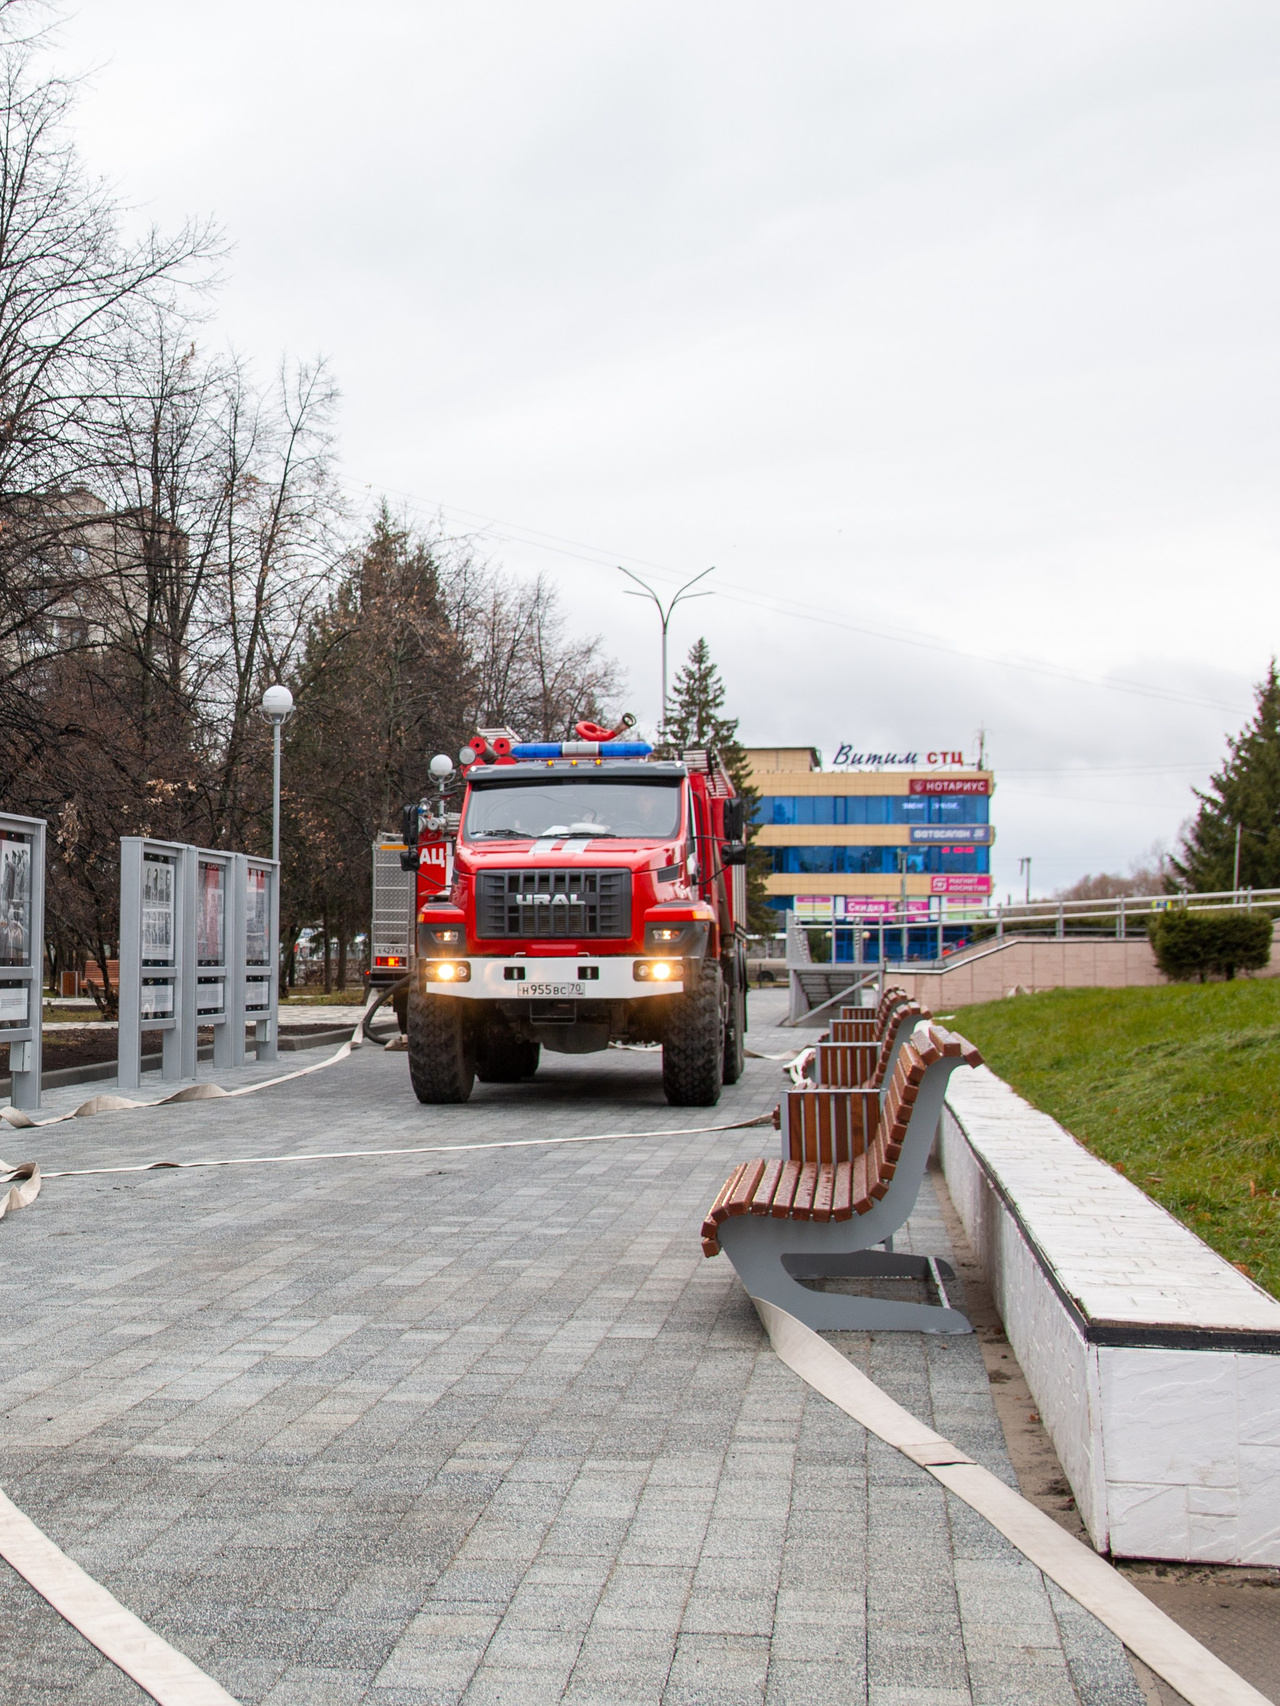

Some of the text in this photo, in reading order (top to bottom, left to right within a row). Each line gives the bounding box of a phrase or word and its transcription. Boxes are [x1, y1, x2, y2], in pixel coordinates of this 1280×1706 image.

[833, 744, 963, 766] Витим СТЦ
[926, 781, 985, 791] НОТАРИУС
[913, 829, 971, 839] ФОТОСАЛОН
[516, 894, 586, 905] URAL
